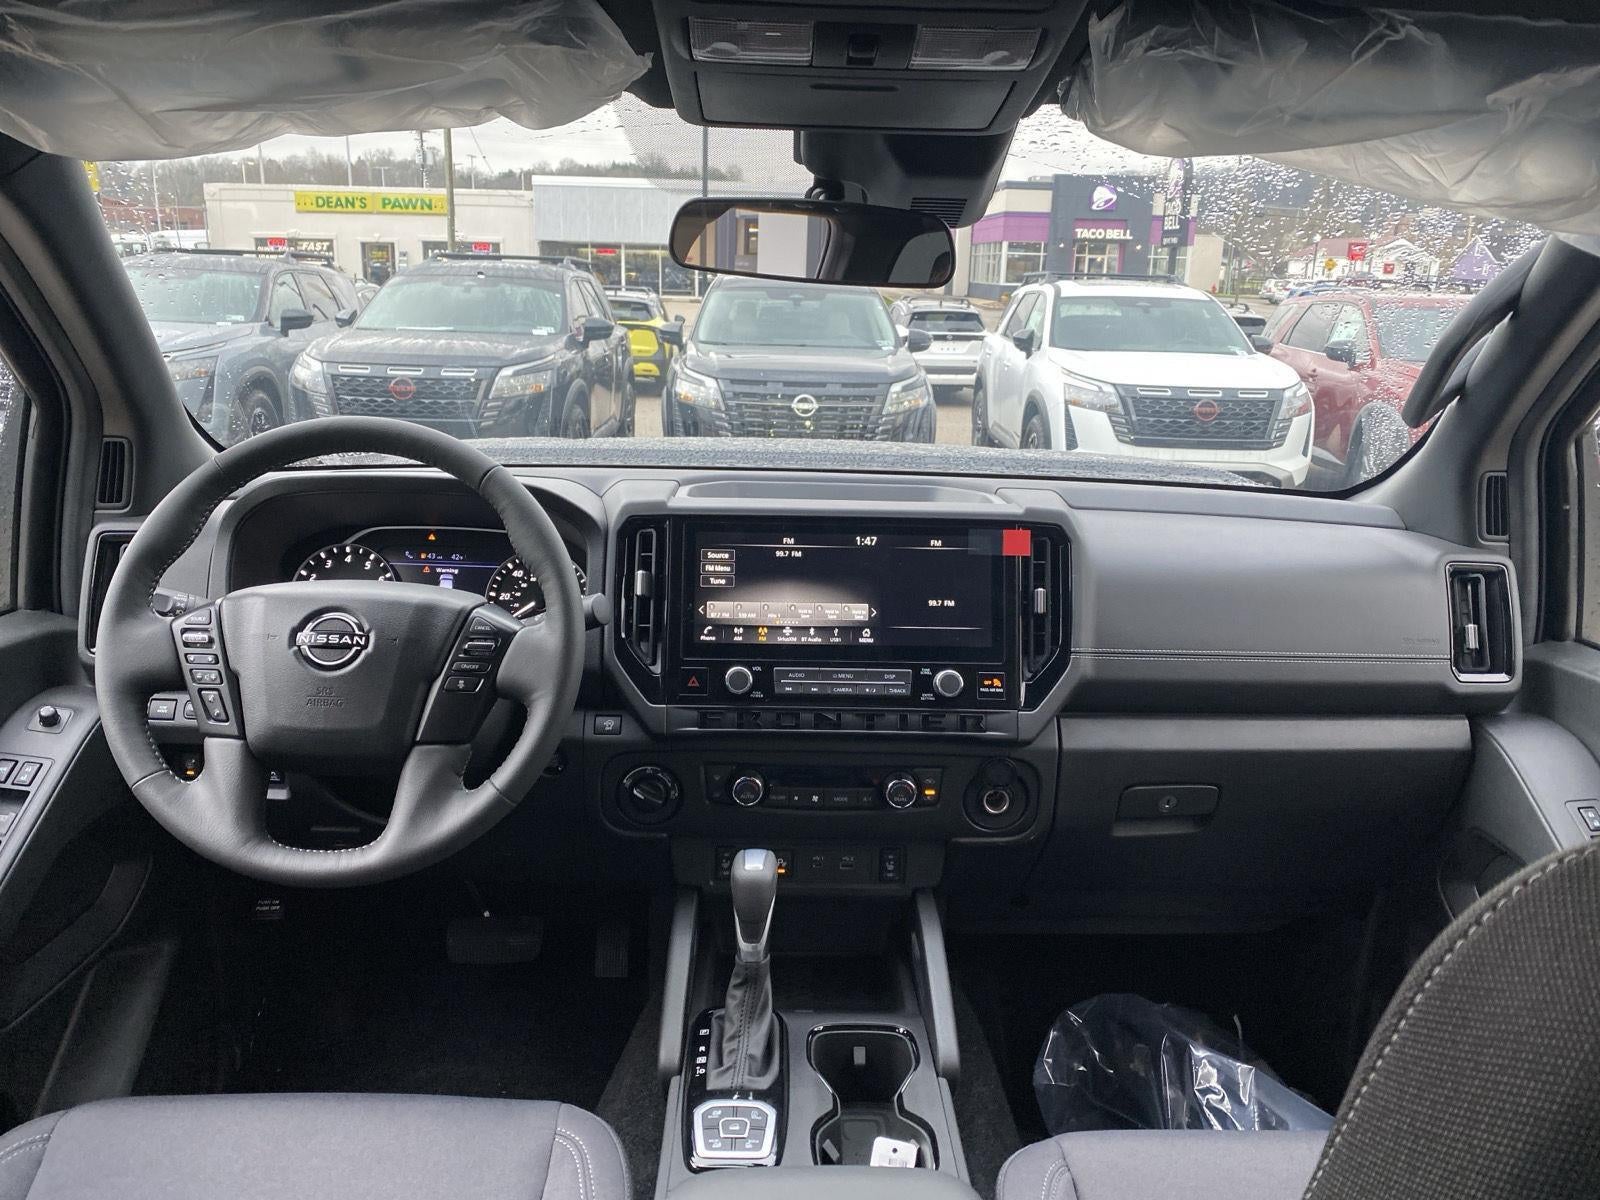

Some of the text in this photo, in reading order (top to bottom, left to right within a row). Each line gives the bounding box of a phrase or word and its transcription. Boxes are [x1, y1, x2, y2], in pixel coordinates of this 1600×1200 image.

[315, 196, 433, 210] DEAN'S PAWN
[1164, 216, 1180, 230] BELL
[1075, 229, 1133, 240] TACO BELL
[302, 241, 330, 251] FAST
[783, 537, 794, 545] FM
[855, 536, 877, 546] 1:47
[930, 539, 942, 547] FM
[344, 555, 352, 563] 4
[707, 551, 729, 559] Source
[325, 560, 332, 569] 3
[364, 561, 371, 570] 5
[309, 573, 317, 581] 2
[512, 570, 523, 578] 40
[298, 634, 366, 645] NISSAN
[317, 687, 335, 696] SRS
[306, 698, 344, 708] AIRBAG
[699, 710, 986, 733] FRONTIER
